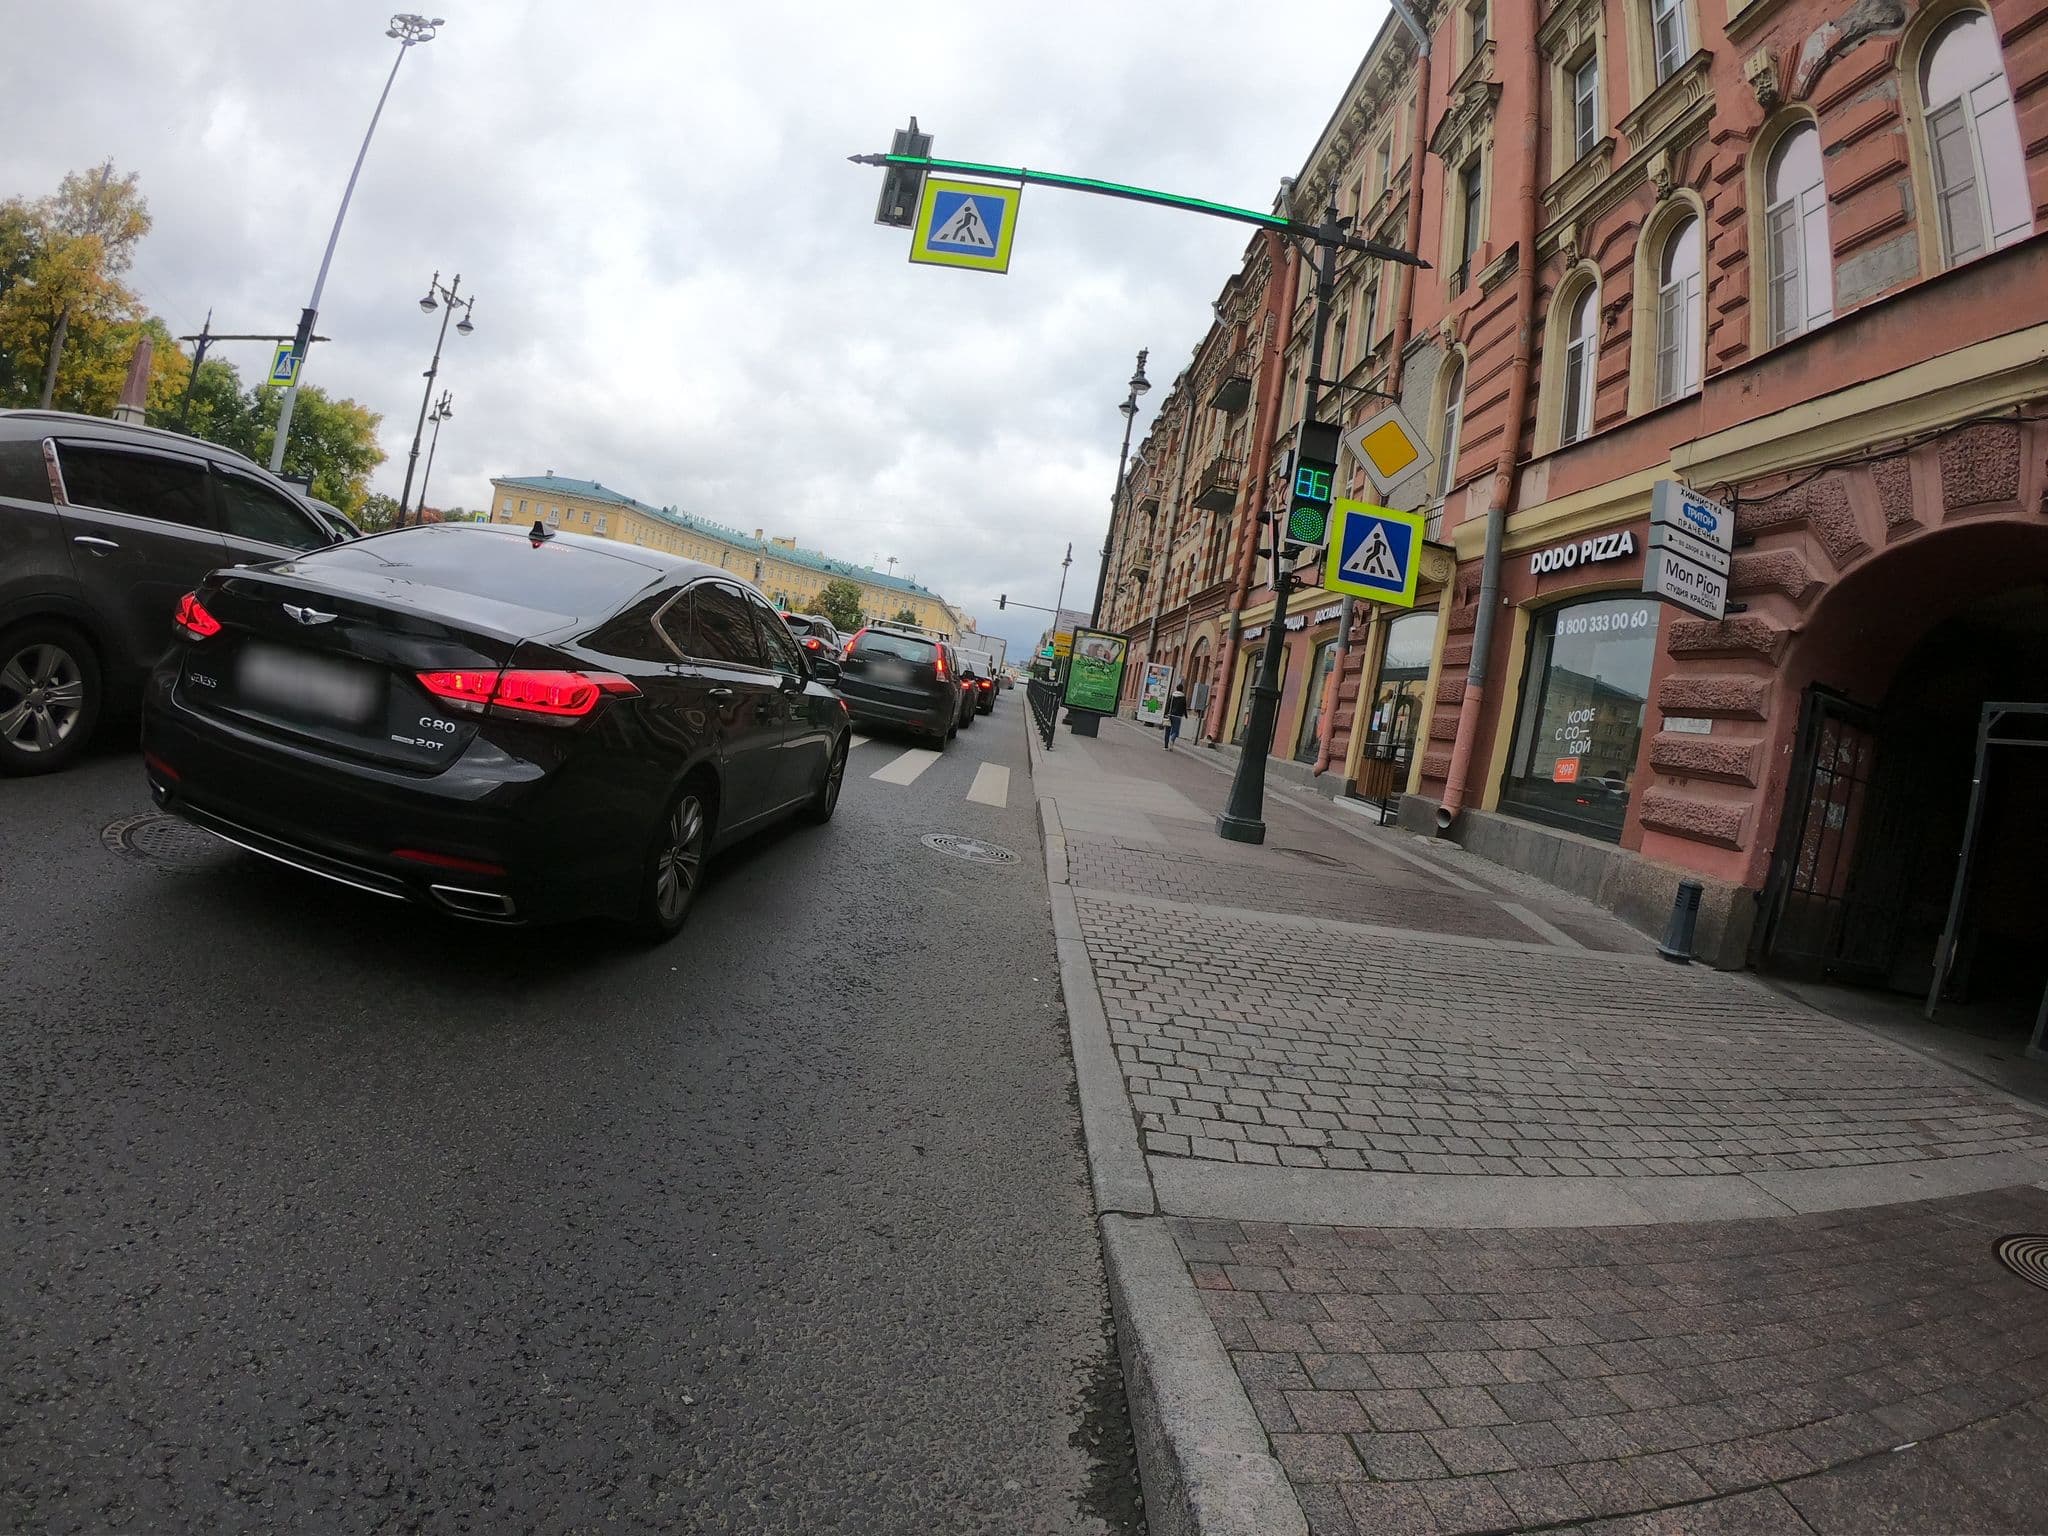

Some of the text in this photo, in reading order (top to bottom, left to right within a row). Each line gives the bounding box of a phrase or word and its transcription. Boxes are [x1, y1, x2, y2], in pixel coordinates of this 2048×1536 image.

[1680, 487, 1722, 515] ХИМЧИСТКА
[1677, 517, 1720, 544] ПРАЧЕЧНАЯ
[1686, 506, 1714, 528] ТРИТОН
[1530, 530, 1634, 574] DODO PIZZA
[1665, 558, 1721, 598] Mon Pion
[1665, 582, 1689, 599] СТУДИЯ
[1689, 592, 1718, 612] КРАСОТЫ
[1557, 609, 1648, 636] 8 800 333 00 60
[419, 716, 456, 734] G80
[1567, 707, 1596, 724] КОФЕ
[1555, 727, 1563, 741] С
[1569, 735, 1592, 755] БОЙ
